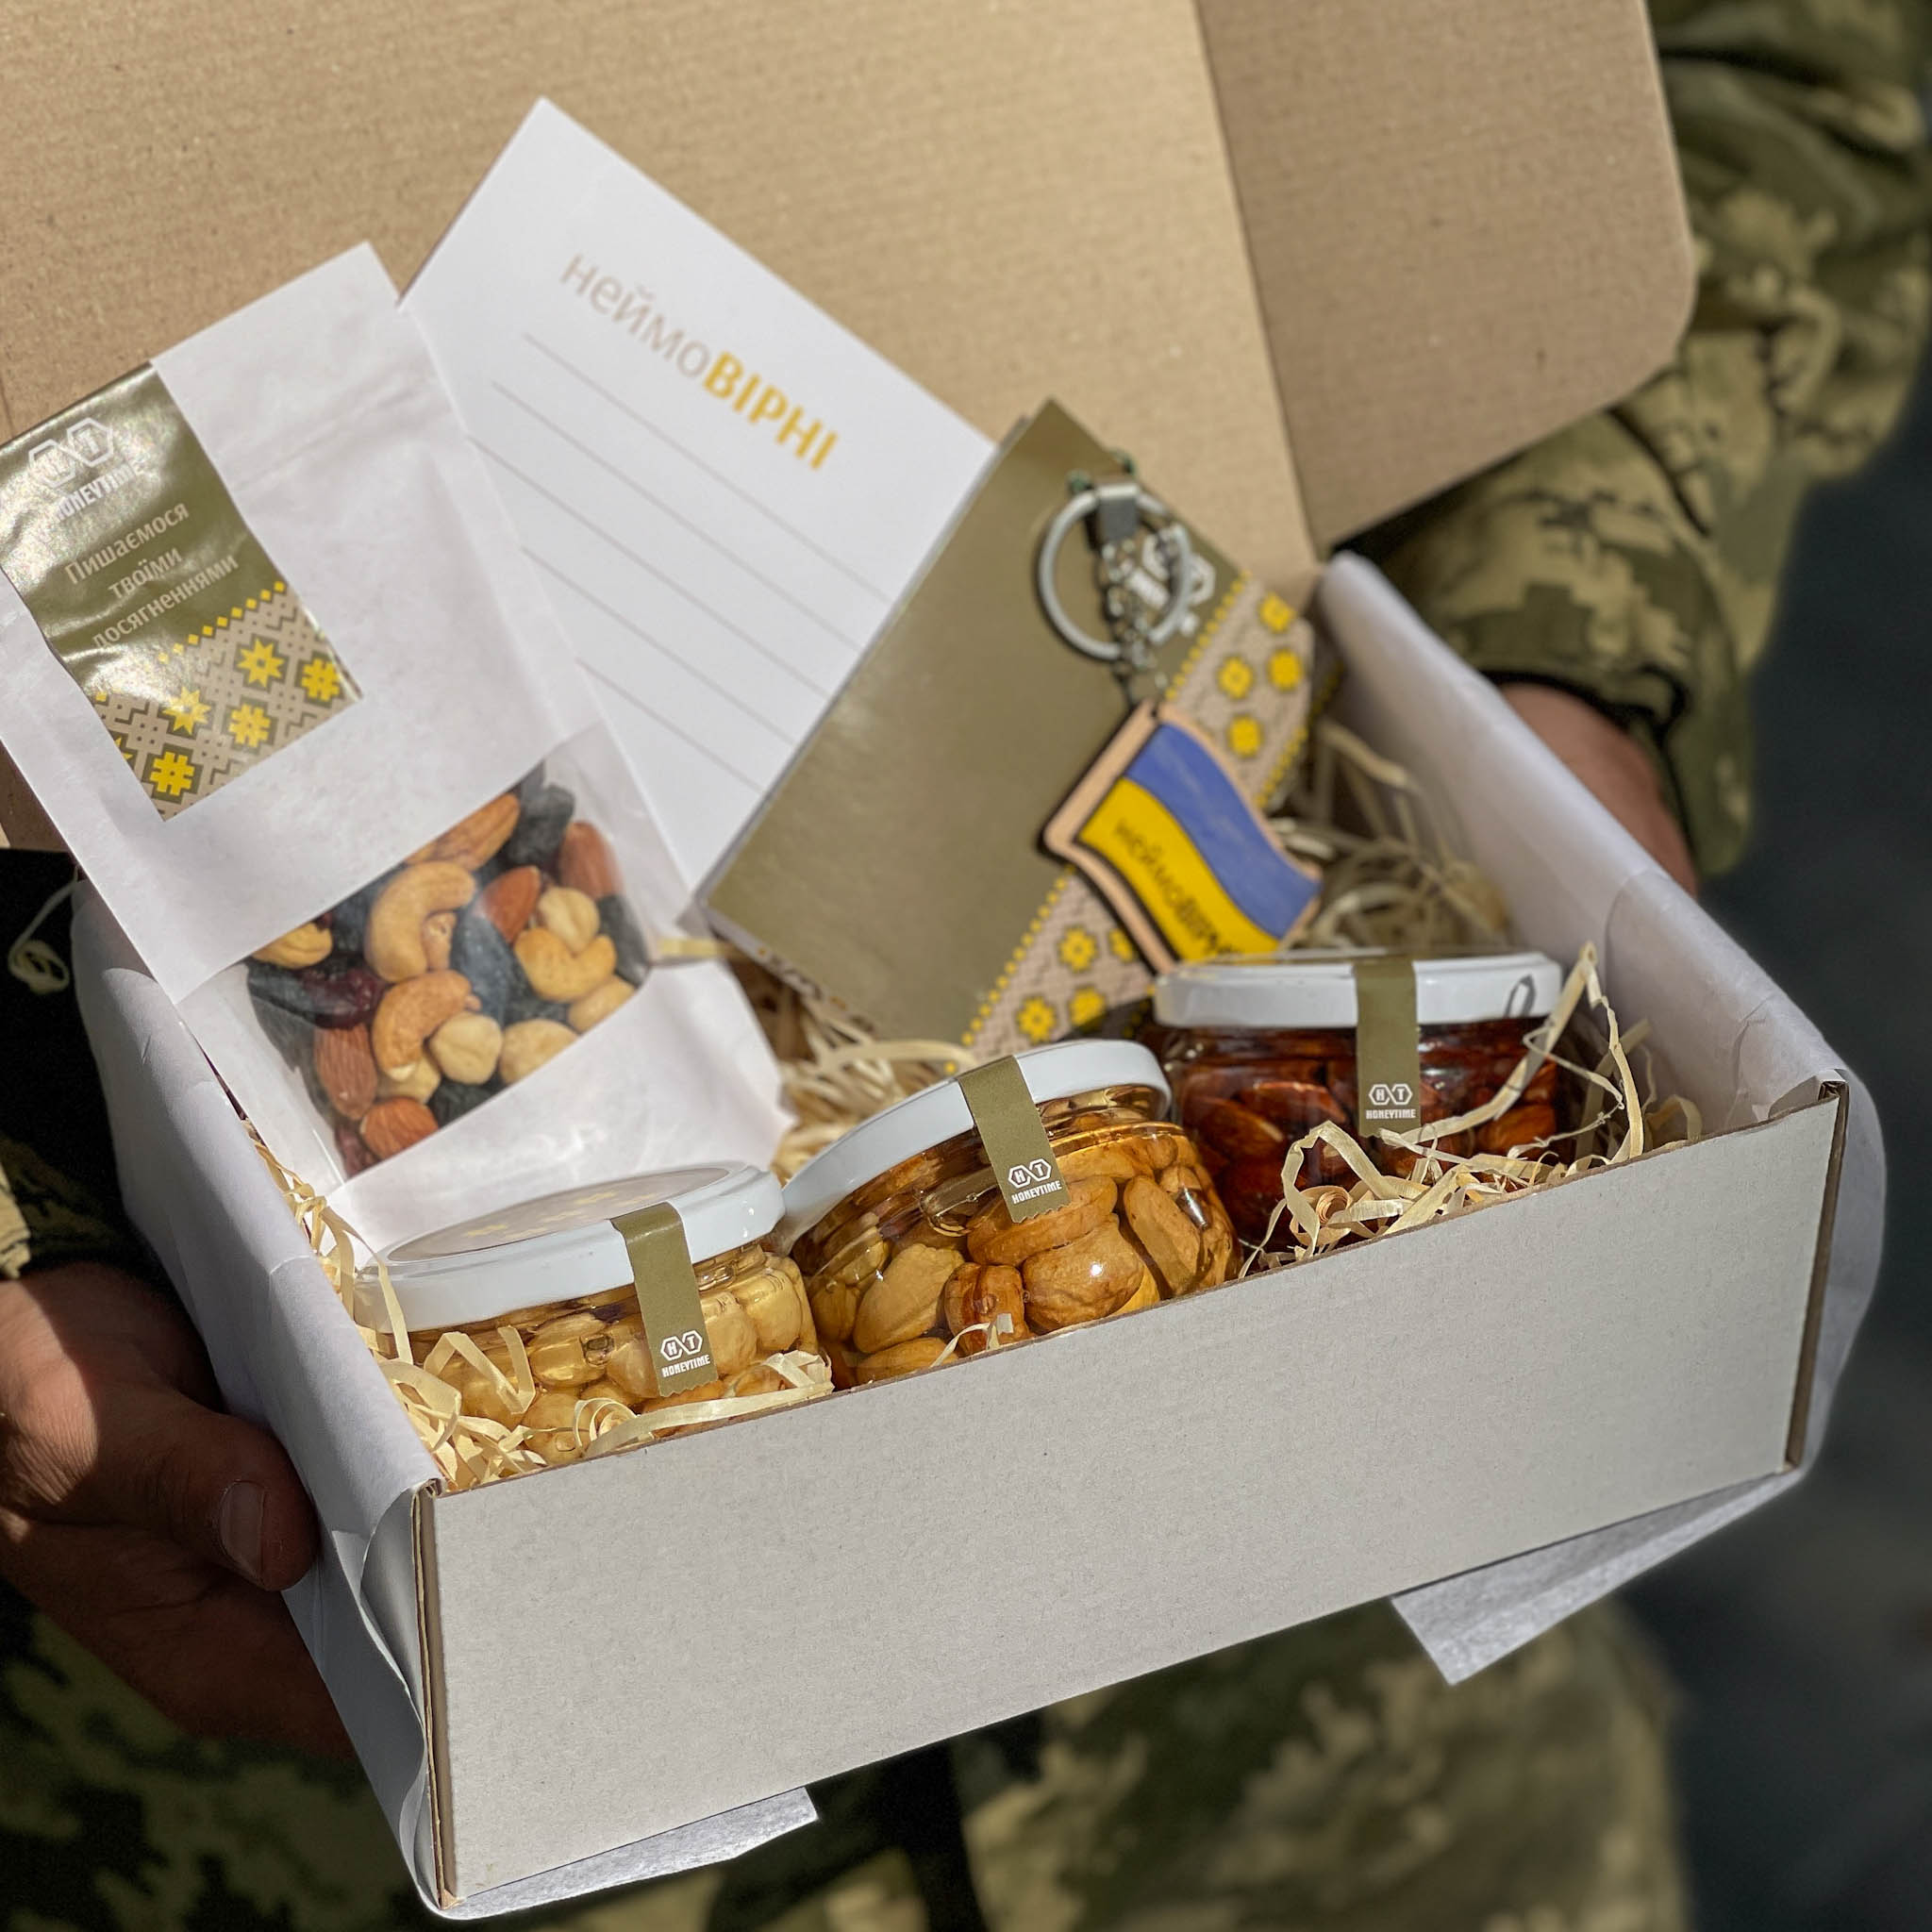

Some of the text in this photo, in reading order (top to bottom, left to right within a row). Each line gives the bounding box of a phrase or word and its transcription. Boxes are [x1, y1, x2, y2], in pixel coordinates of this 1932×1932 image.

[559, 254, 839, 471] неймоВІРНІ
[64, 503, 190, 585] Пишаємося
[108, 547, 183, 599] твоїми
[92, 555, 239, 649] досягненнями
[1365, 1108, 1416, 1120] HONEYTIME
[1011, 1180, 1063, 1205] HONEYTIME
[661, 1354, 711, 1378] HONEYTIME
